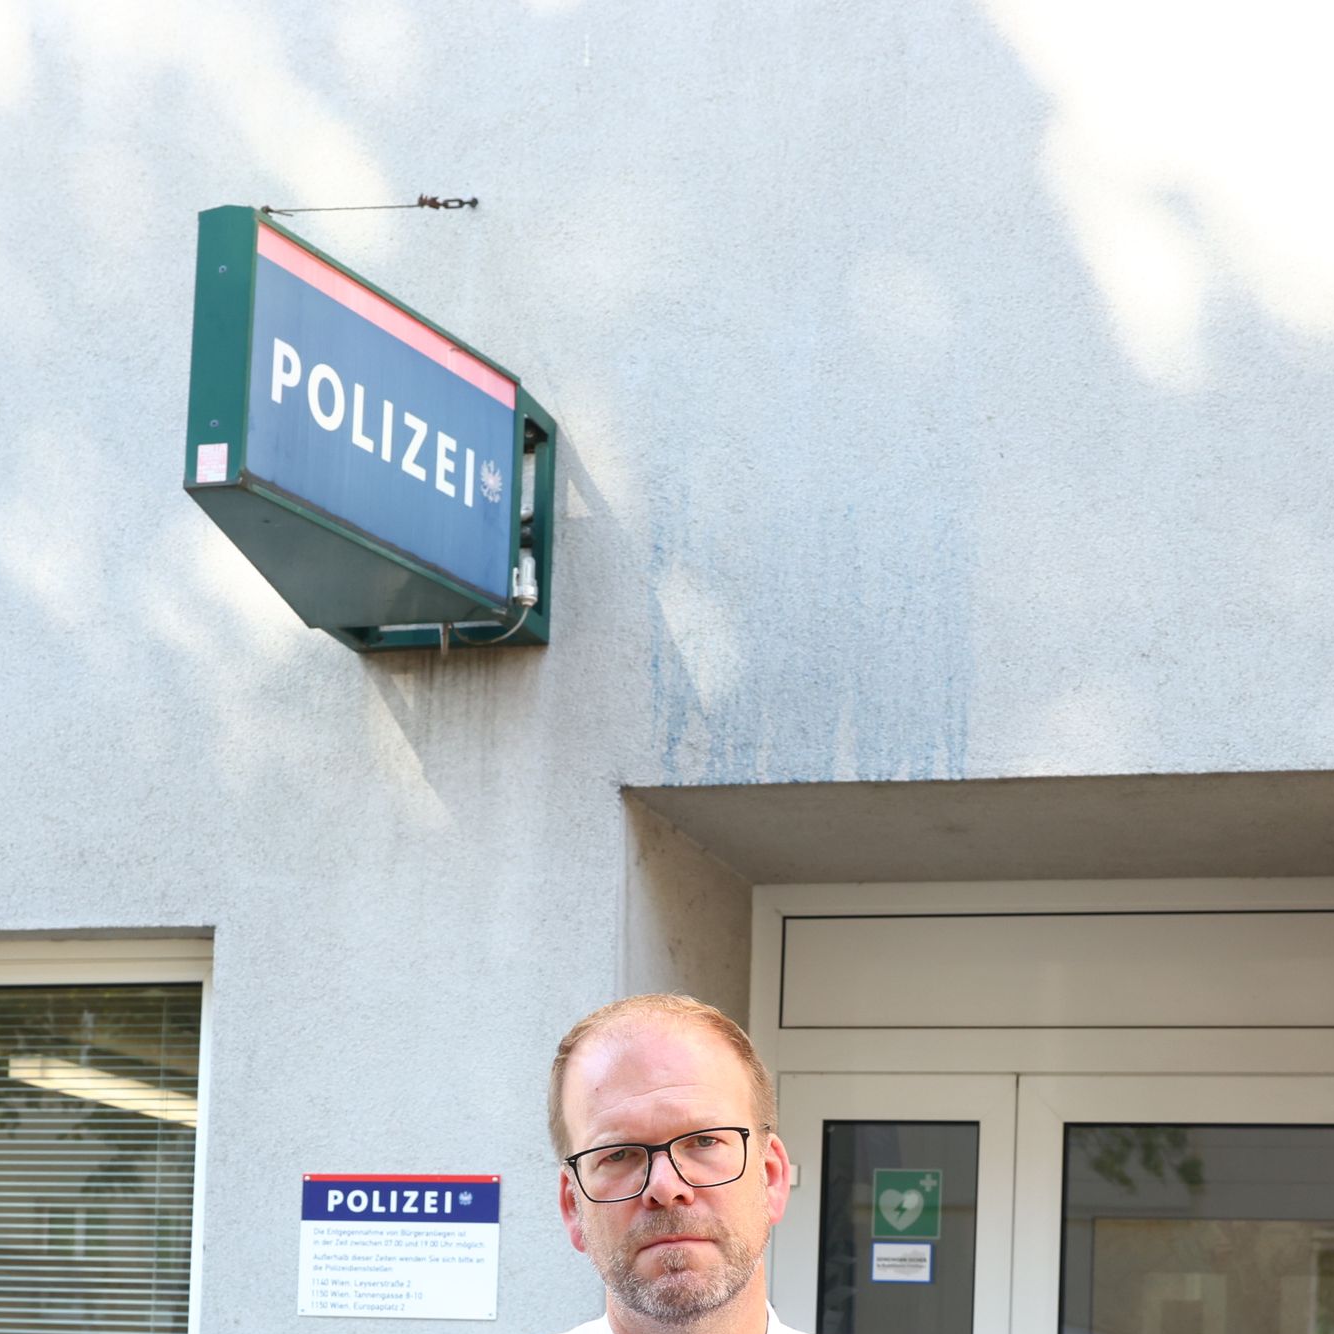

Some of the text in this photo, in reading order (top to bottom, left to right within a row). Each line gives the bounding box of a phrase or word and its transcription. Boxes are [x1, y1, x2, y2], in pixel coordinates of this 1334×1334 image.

[271, 337, 475, 508] POLIZEI
[327, 1189, 452, 1214] POLIZEI
[313, 1227, 324, 1235] Die
[326, 1227, 383, 1237] Entgegennahme
[350, 1239, 382, 1247] zwischen
[405, 1240, 418, 1248] und
[440, 1240, 453, 1248] Uhr
[313, 1253, 349, 1261] Außerhalb
[352, 1253, 372, 1261] dieser
[375, 1254, 396, 1262] Zeiten
[399, 1254, 426, 1262] wenden
[428, 1255, 440, 1263] Sie
[458, 1256, 474, 1264] bitte
[354, 1290, 403, 1300] Tannengasse
[354, 1302, 398, 1312] Europaplatz
